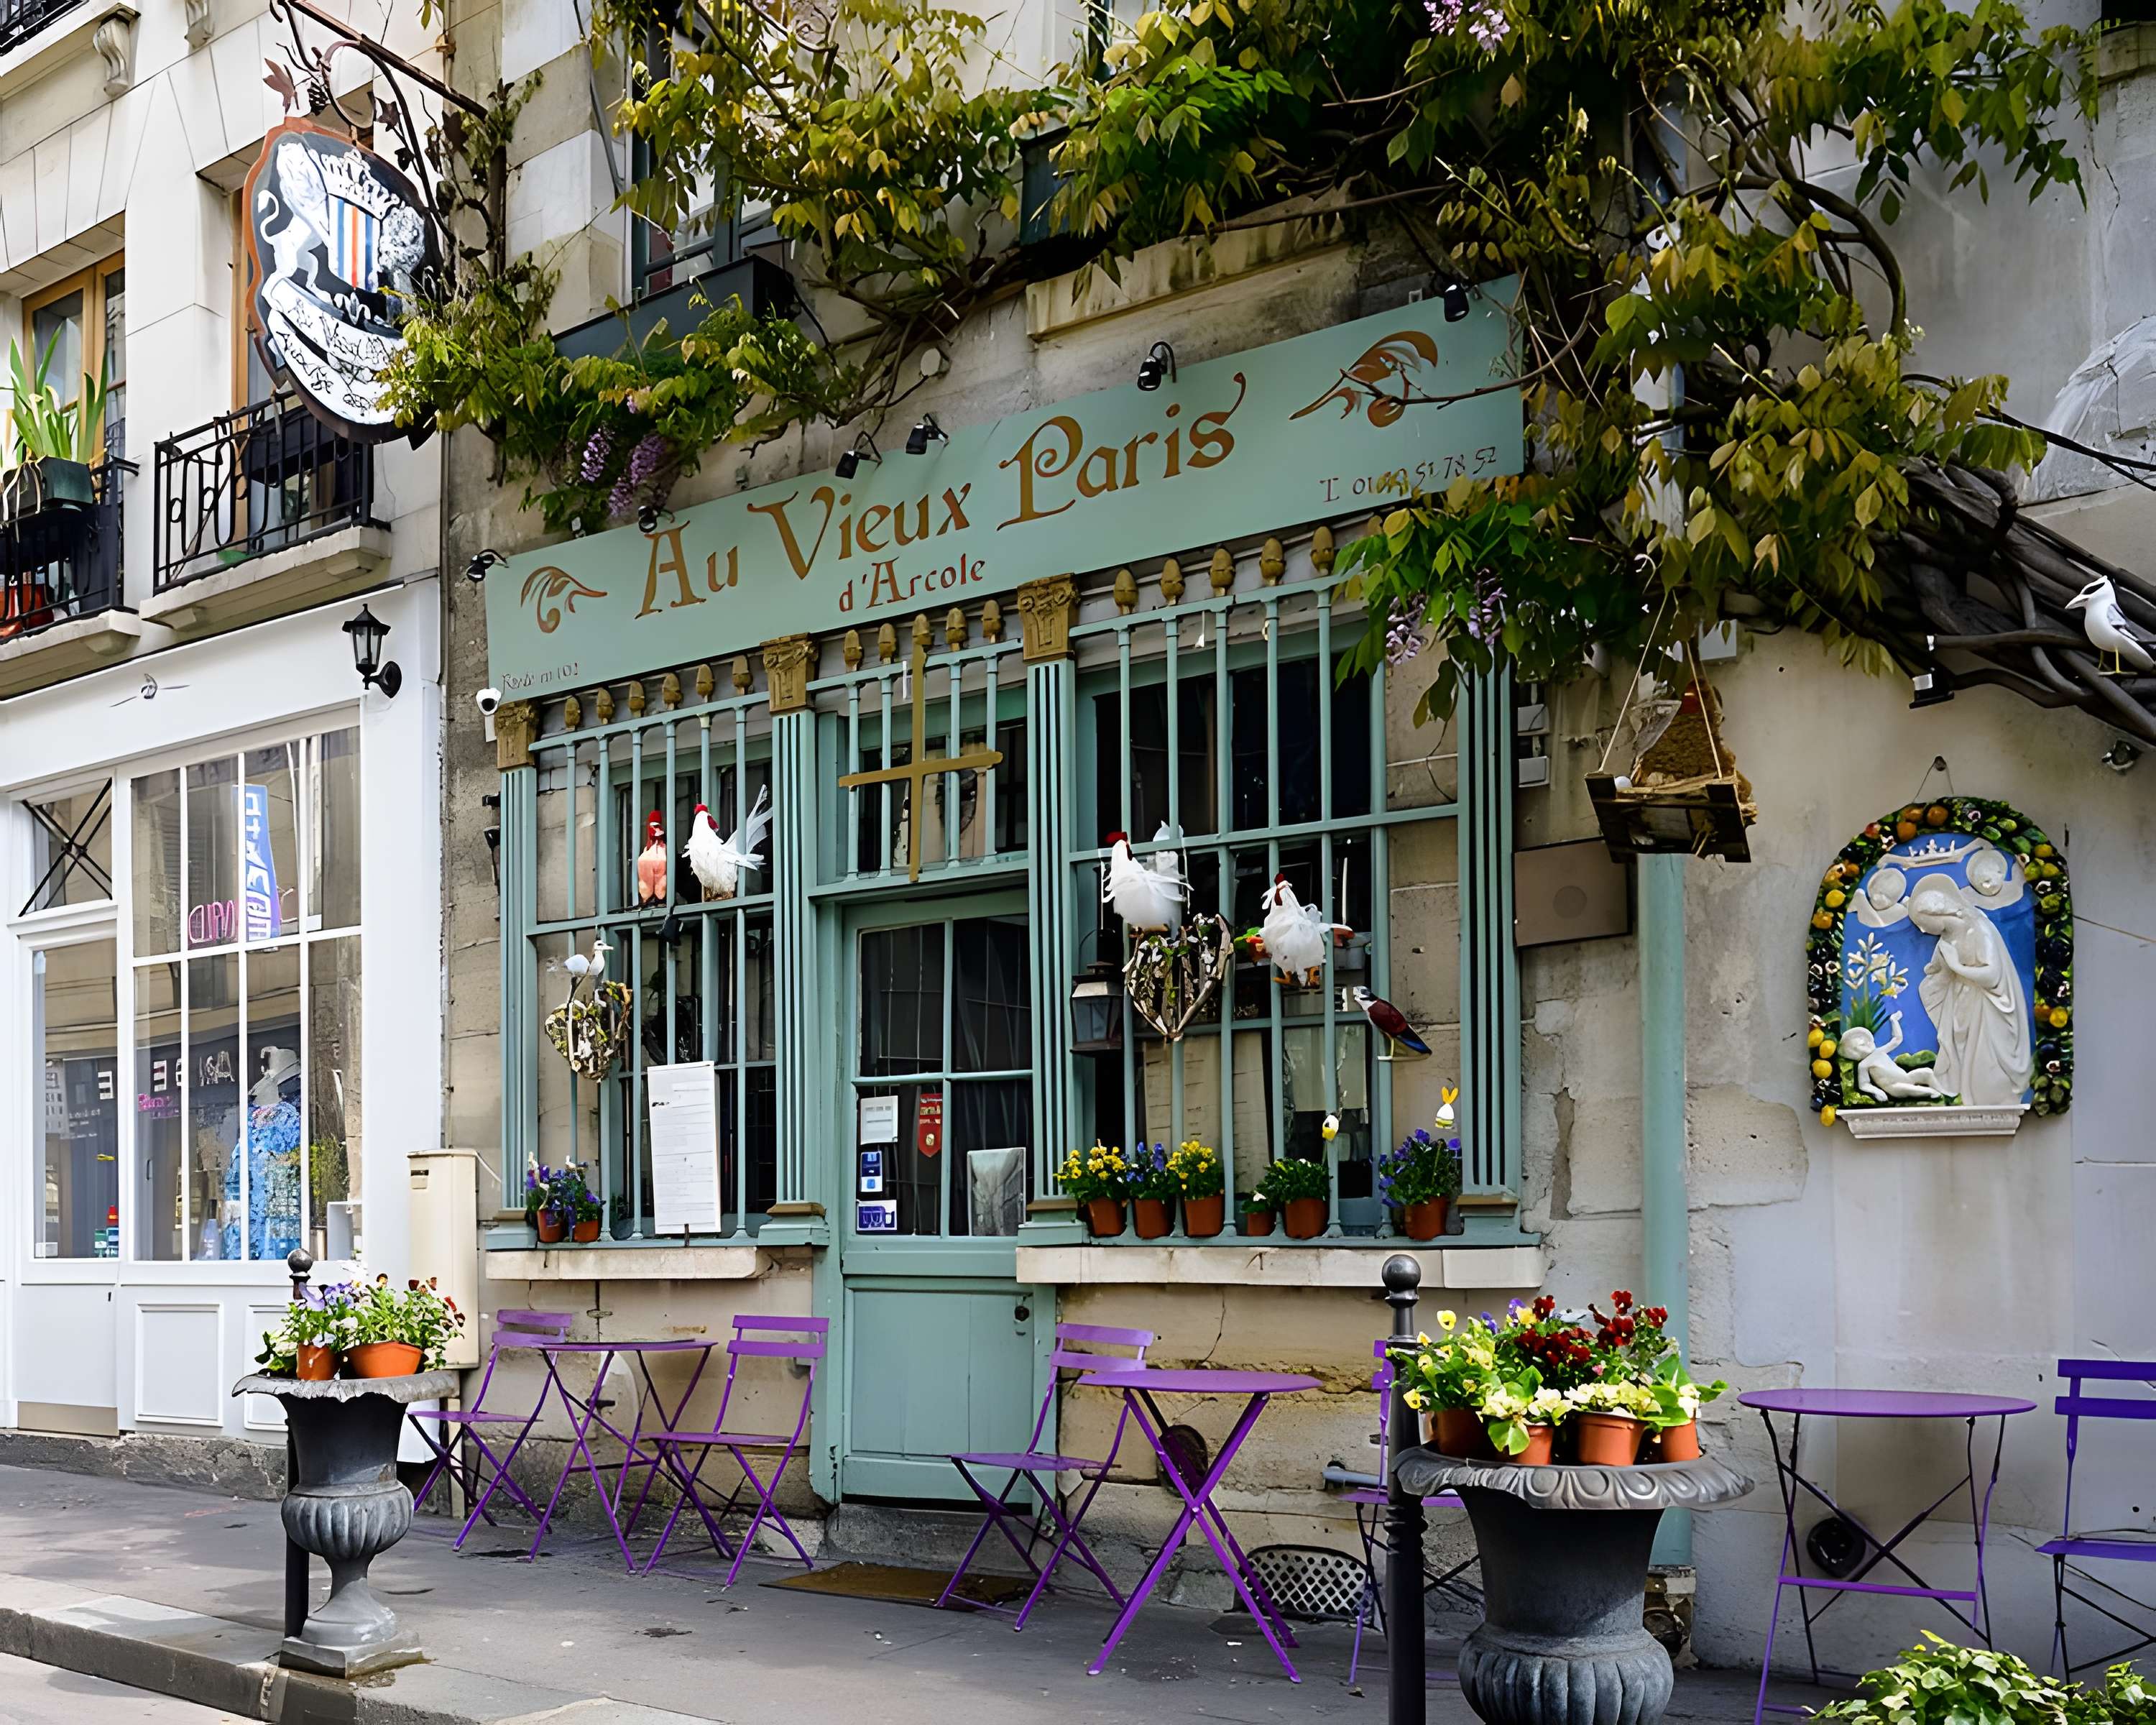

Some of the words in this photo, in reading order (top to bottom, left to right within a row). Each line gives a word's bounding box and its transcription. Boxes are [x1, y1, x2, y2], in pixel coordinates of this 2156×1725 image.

[635, 520, 738, 619] Au
[747, 483, 971, 580] Vieux
[997, 372, 1246, 530] Paris
[839, 553, 985, 612] d'Arcole
